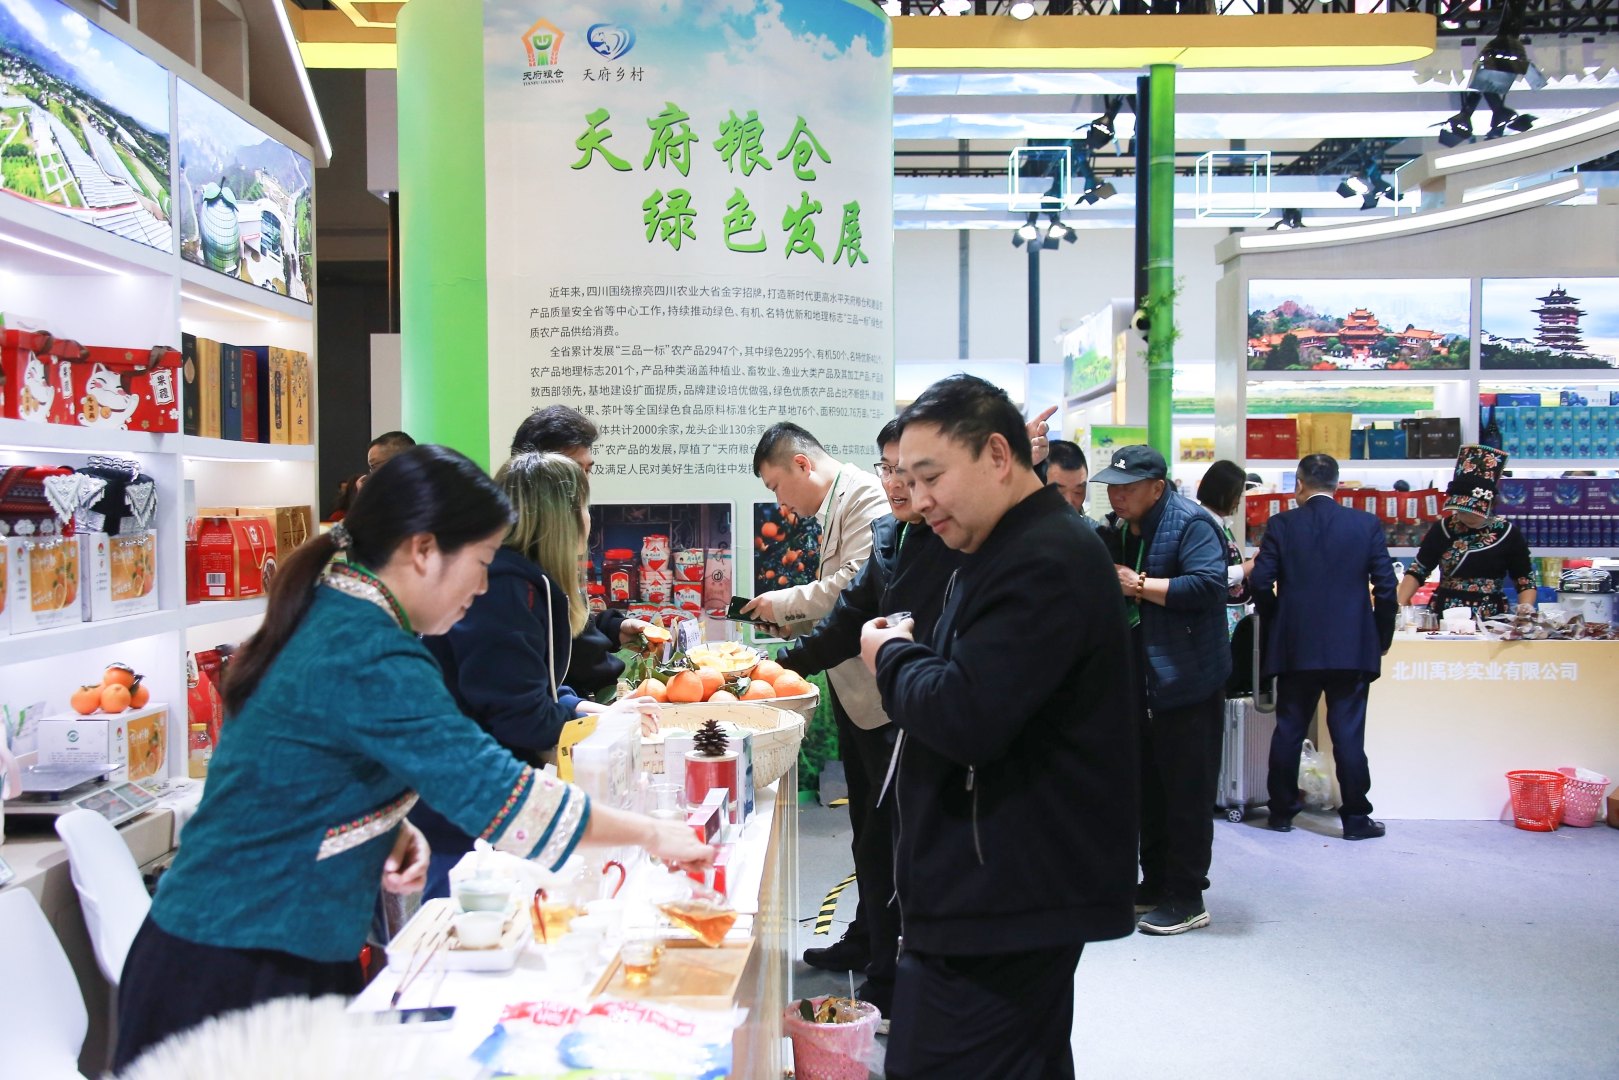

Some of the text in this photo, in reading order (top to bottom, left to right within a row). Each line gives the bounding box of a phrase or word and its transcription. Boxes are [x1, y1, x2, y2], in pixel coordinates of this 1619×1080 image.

[522, 68, 564, 81] 天府粮仓
[582, 66, 645, 82] 天府乡村
[570, 101, 832, 182] 天府粮仓
[642, 187, 870, 268] 绿色发展
[1391, 661, 1579, 682] 北川禹珍实业有限公司
